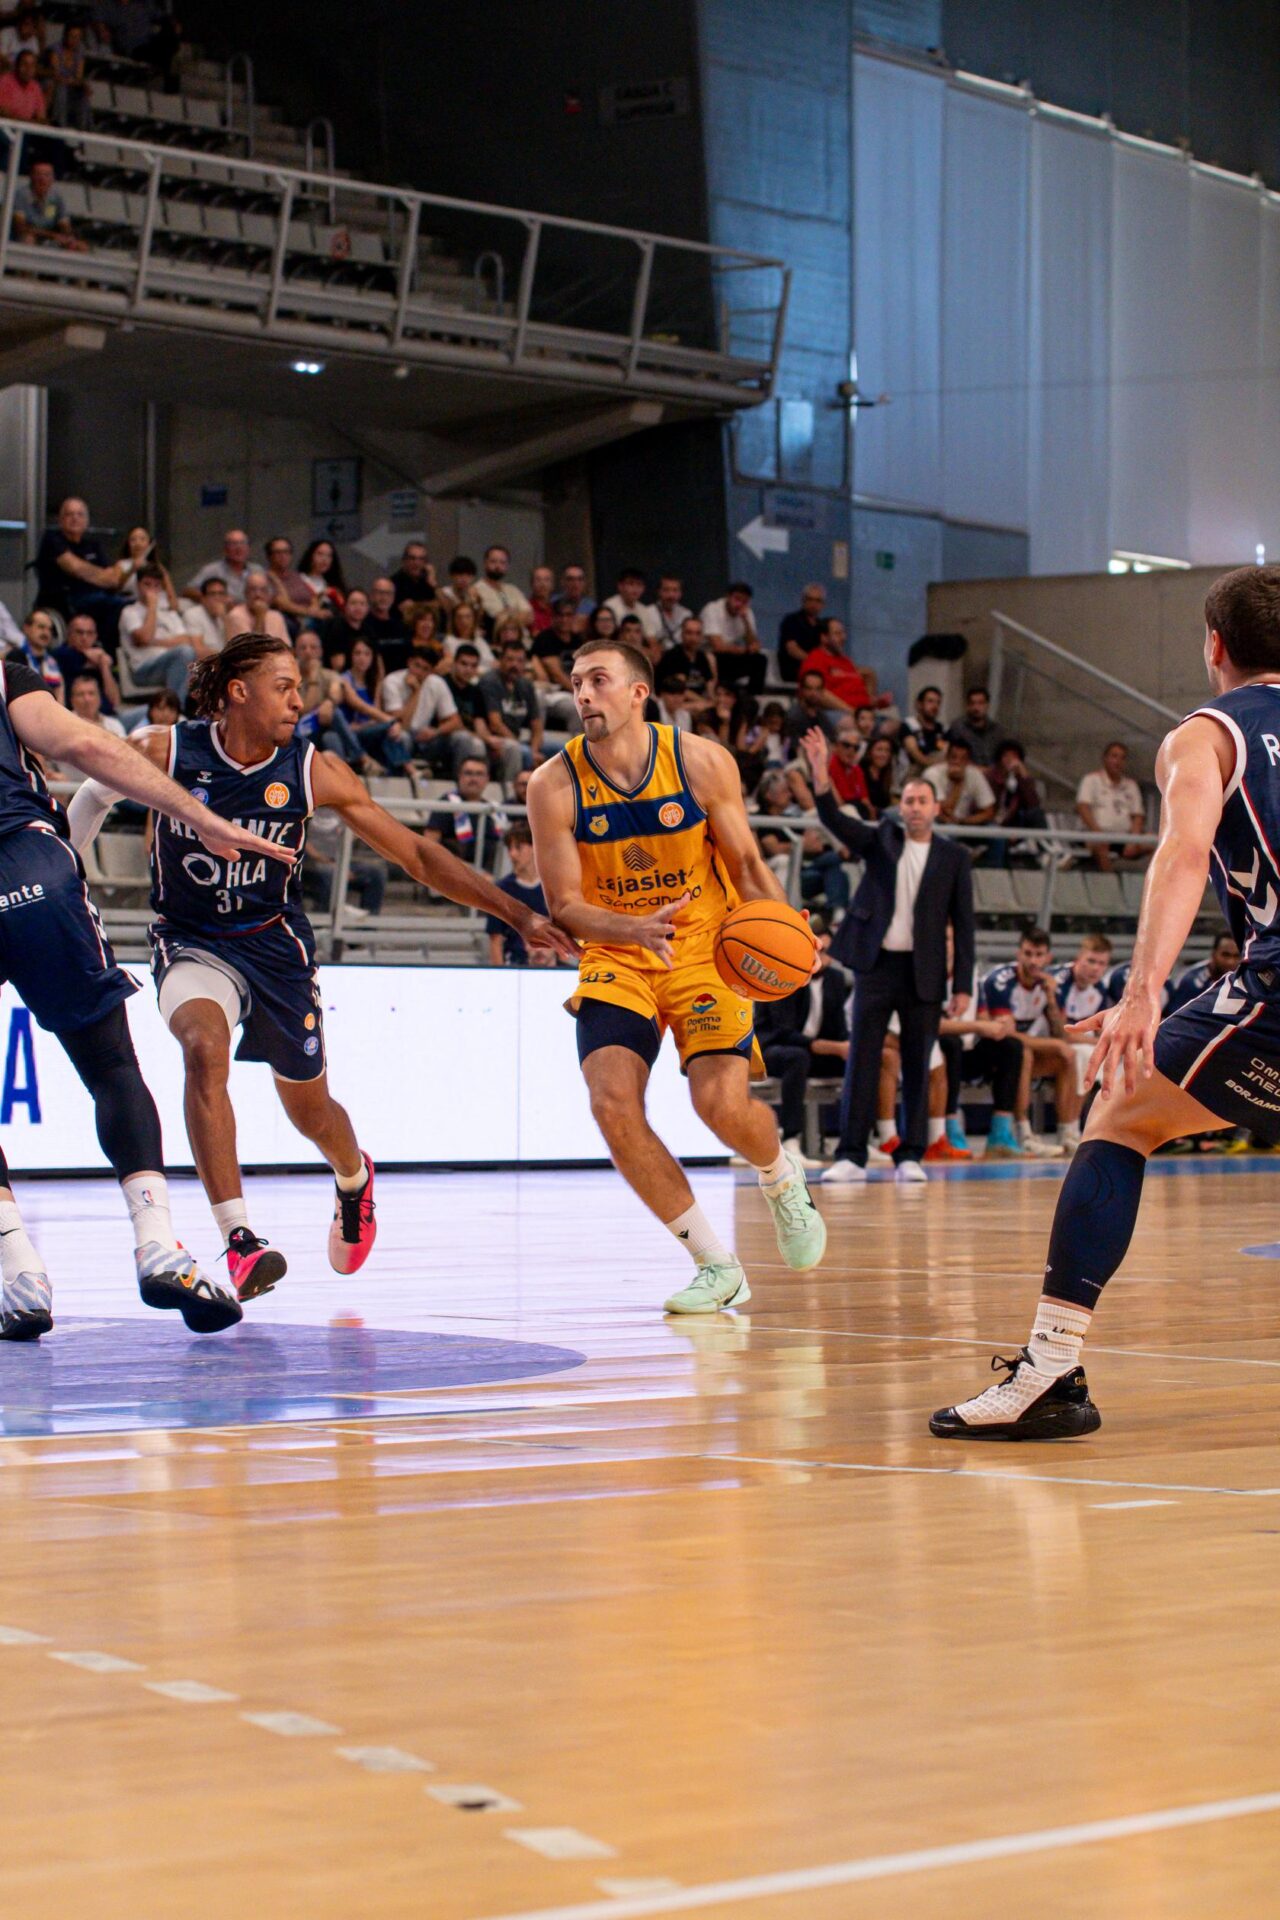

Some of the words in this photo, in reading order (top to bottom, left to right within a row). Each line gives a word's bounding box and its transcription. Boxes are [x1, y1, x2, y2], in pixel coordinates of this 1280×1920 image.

[226, 857, 266, 889] HLA
[740, 953, 796, 990] Wilson
[0, 1007, 42, 1124] A
